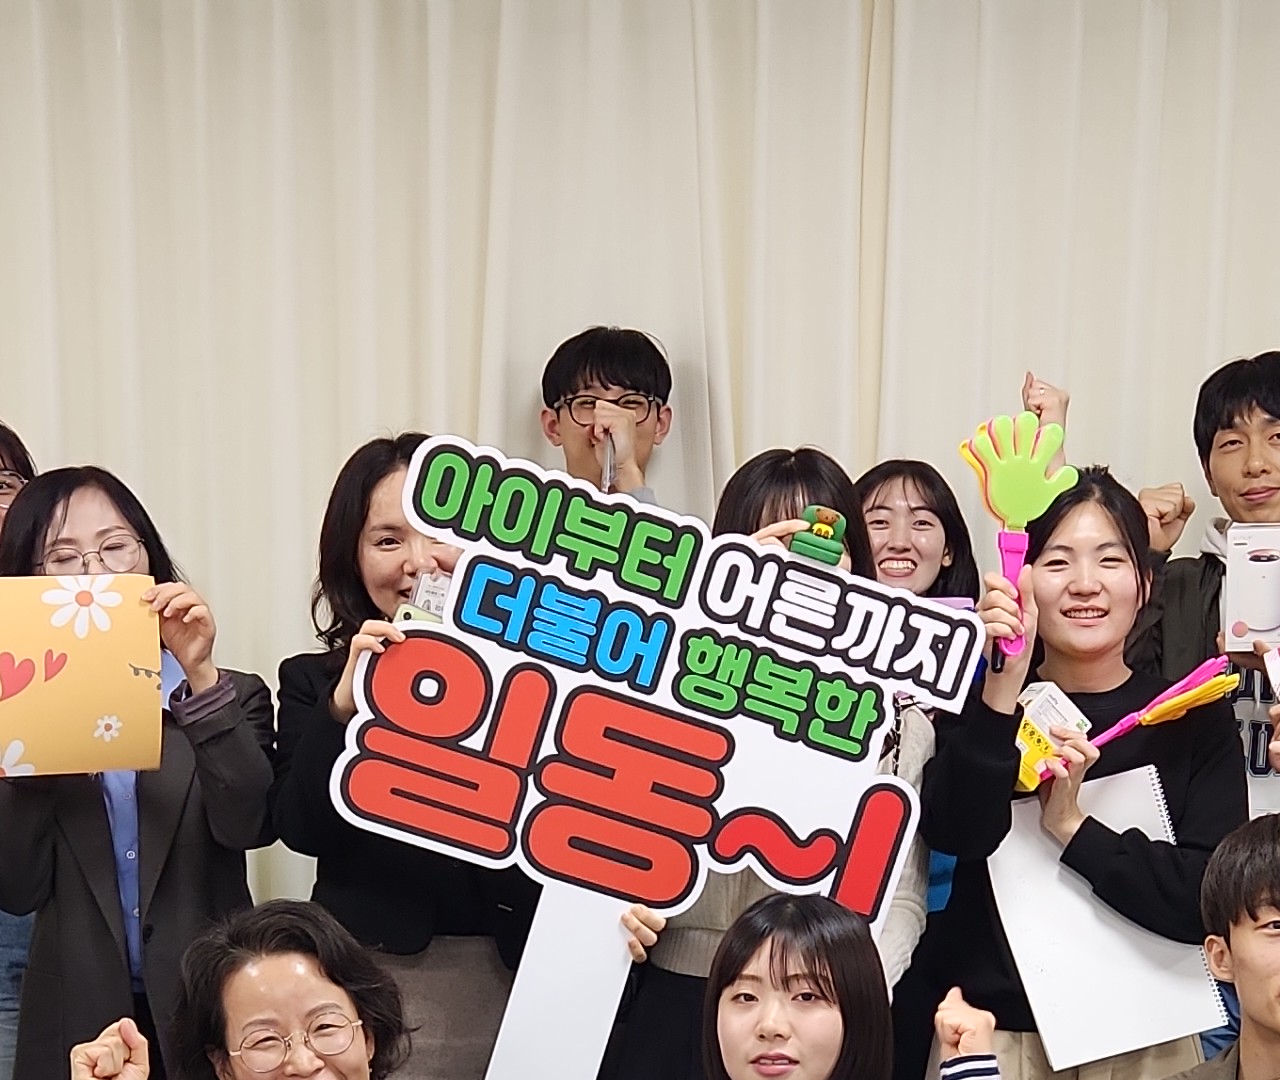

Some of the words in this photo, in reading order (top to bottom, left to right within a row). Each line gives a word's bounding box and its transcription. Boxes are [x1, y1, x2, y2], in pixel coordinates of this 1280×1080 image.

[419, 452, 698, 604] 아이부터
[705, 546, 979, 695] 어른까지
[458, 562, 669, 689] 더불어
[679, 633, 879, 757] 행복한
